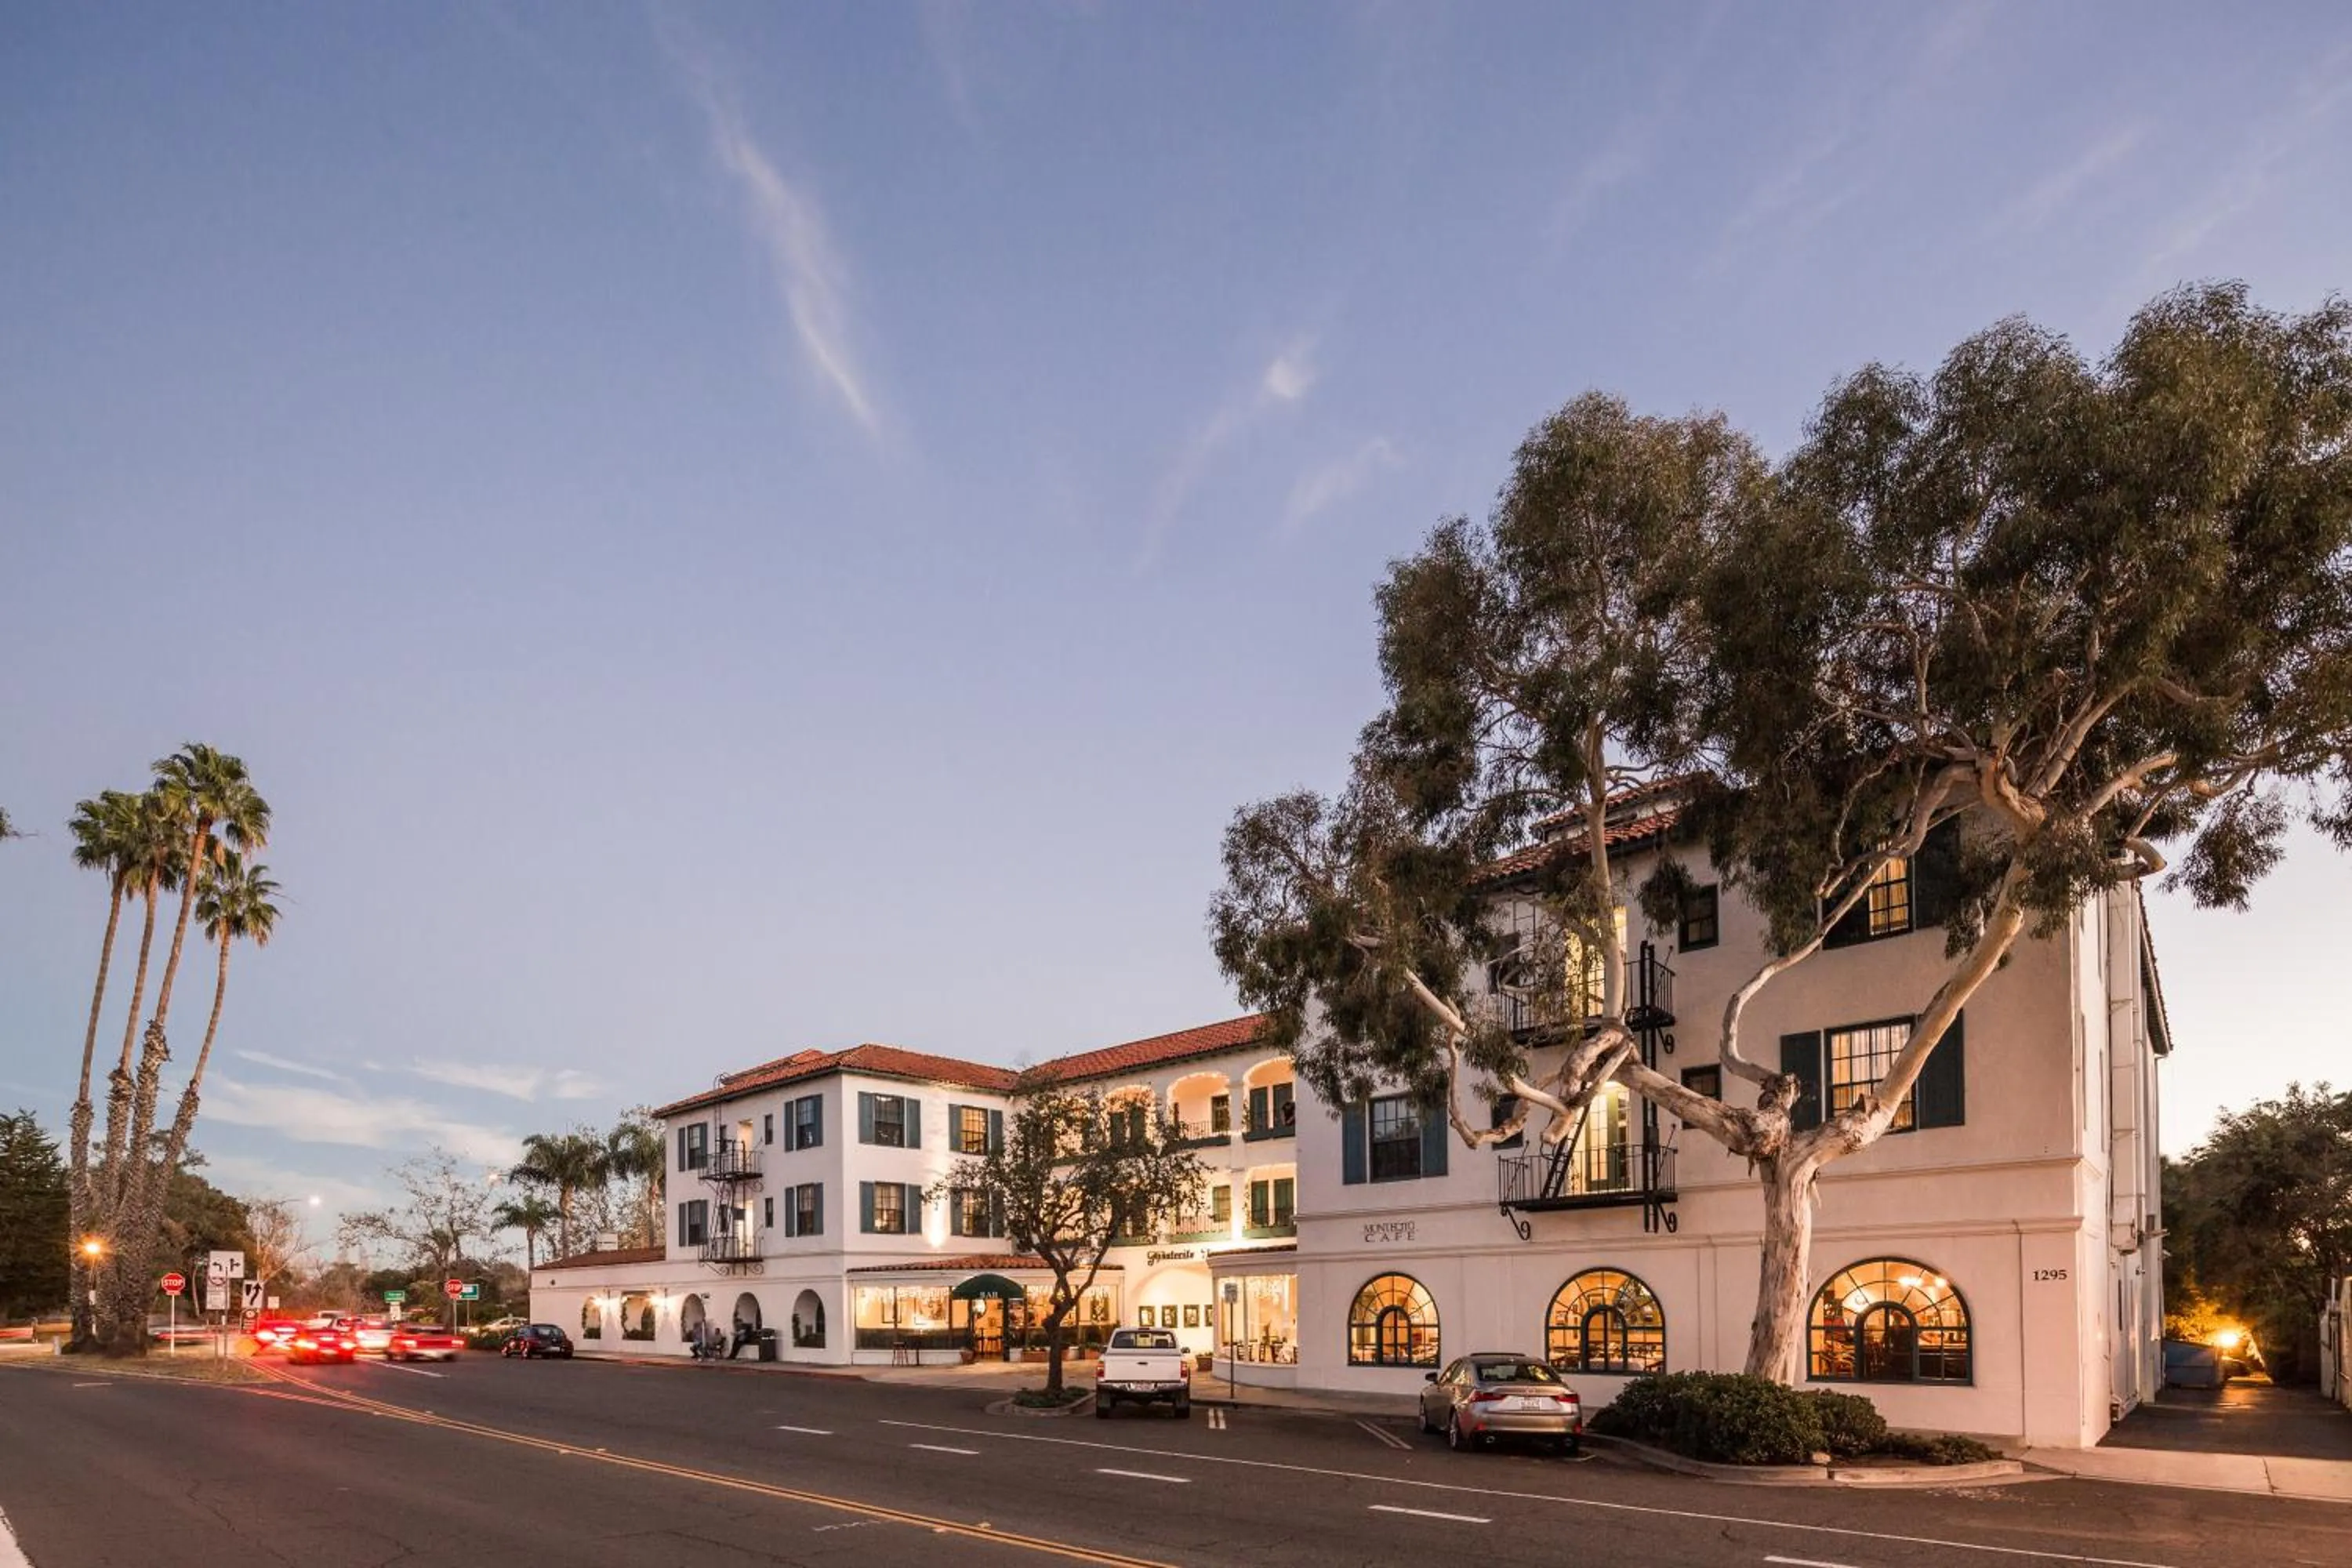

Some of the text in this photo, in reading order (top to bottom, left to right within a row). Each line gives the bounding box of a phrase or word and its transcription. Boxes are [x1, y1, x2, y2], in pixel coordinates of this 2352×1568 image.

[1364, 1221, 1415, 1232] MONTECITO
[1365, 1232, 1415, 1243] CAFE
[2033, 1269, 2067, 1280] 1295
